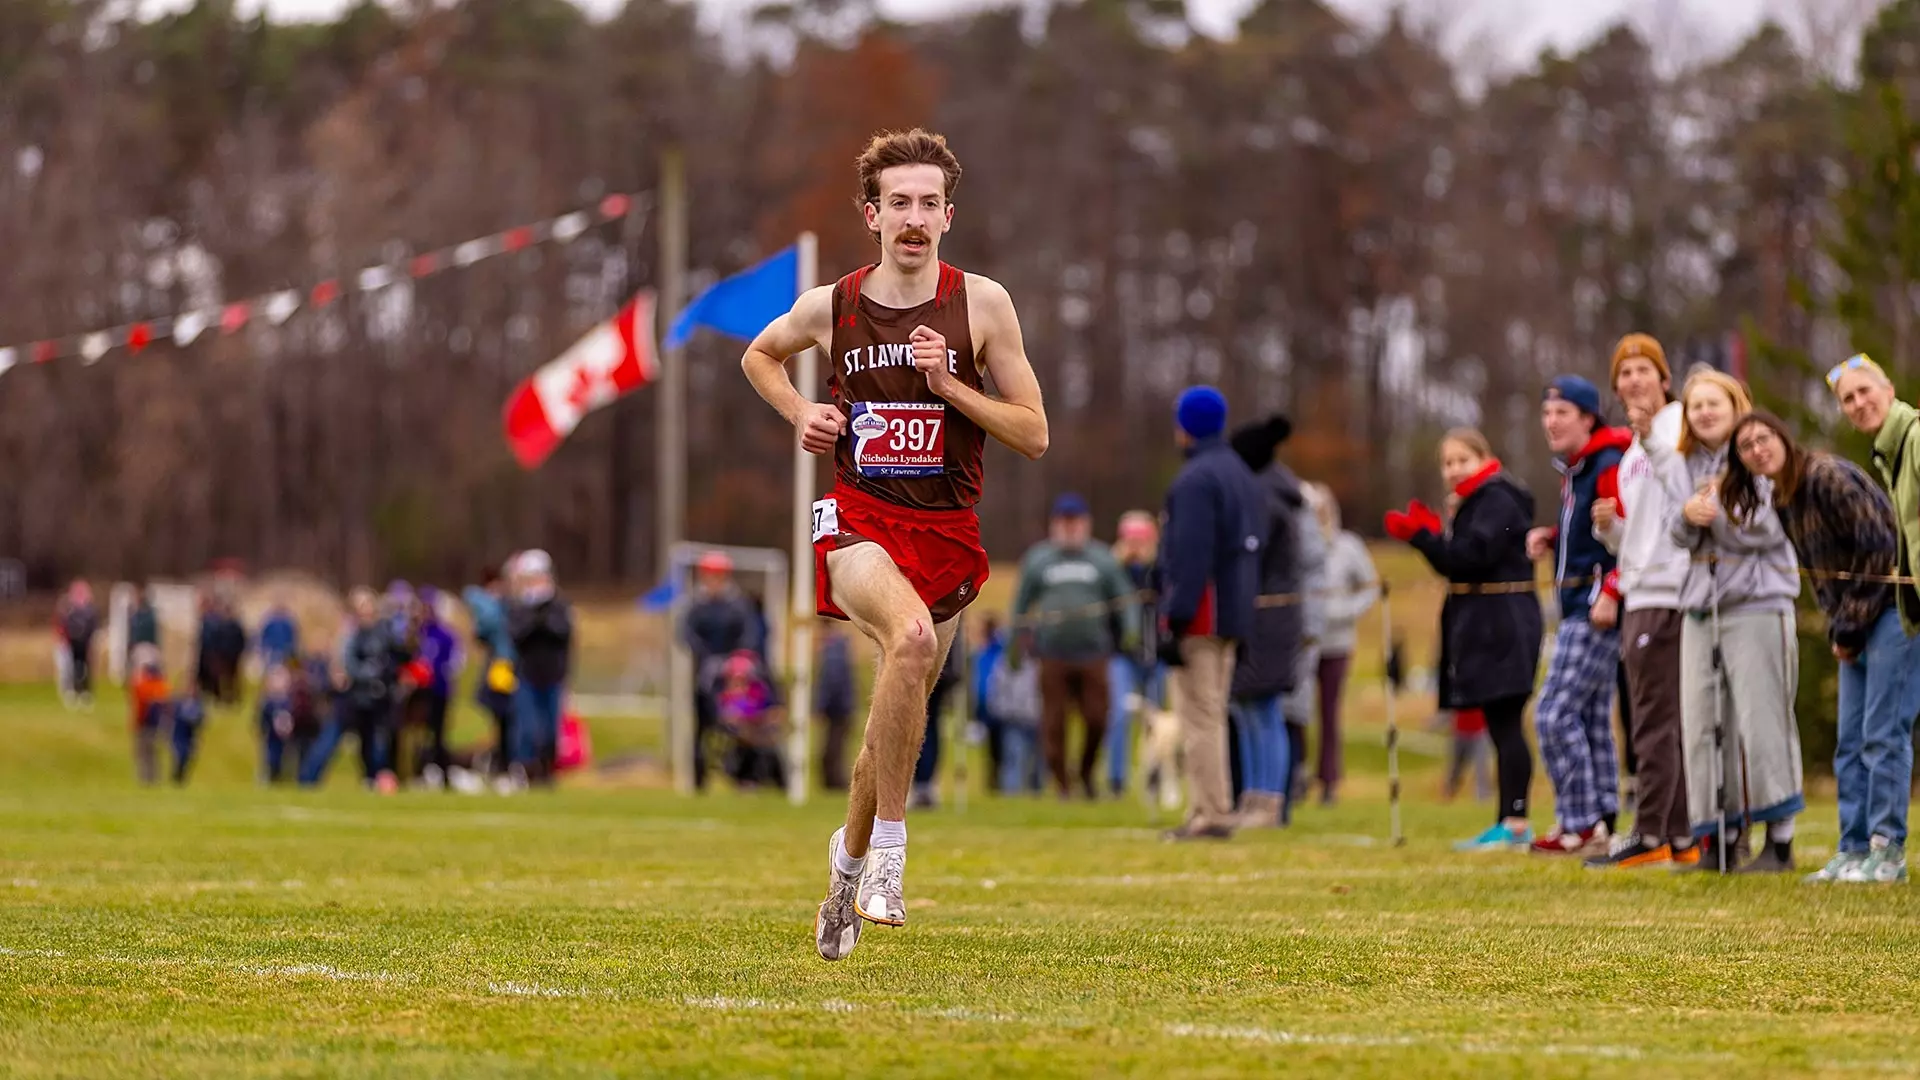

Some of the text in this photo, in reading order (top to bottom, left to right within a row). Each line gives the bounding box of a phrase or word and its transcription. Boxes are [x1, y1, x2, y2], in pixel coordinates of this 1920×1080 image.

[844, 343, 958, 376] ST. LAWRE
[889, 418, 941, 451] 397
[861, 453, 943, 465] Nicholas Lyndaker
[890, 467, 921, 475] Lawrence
